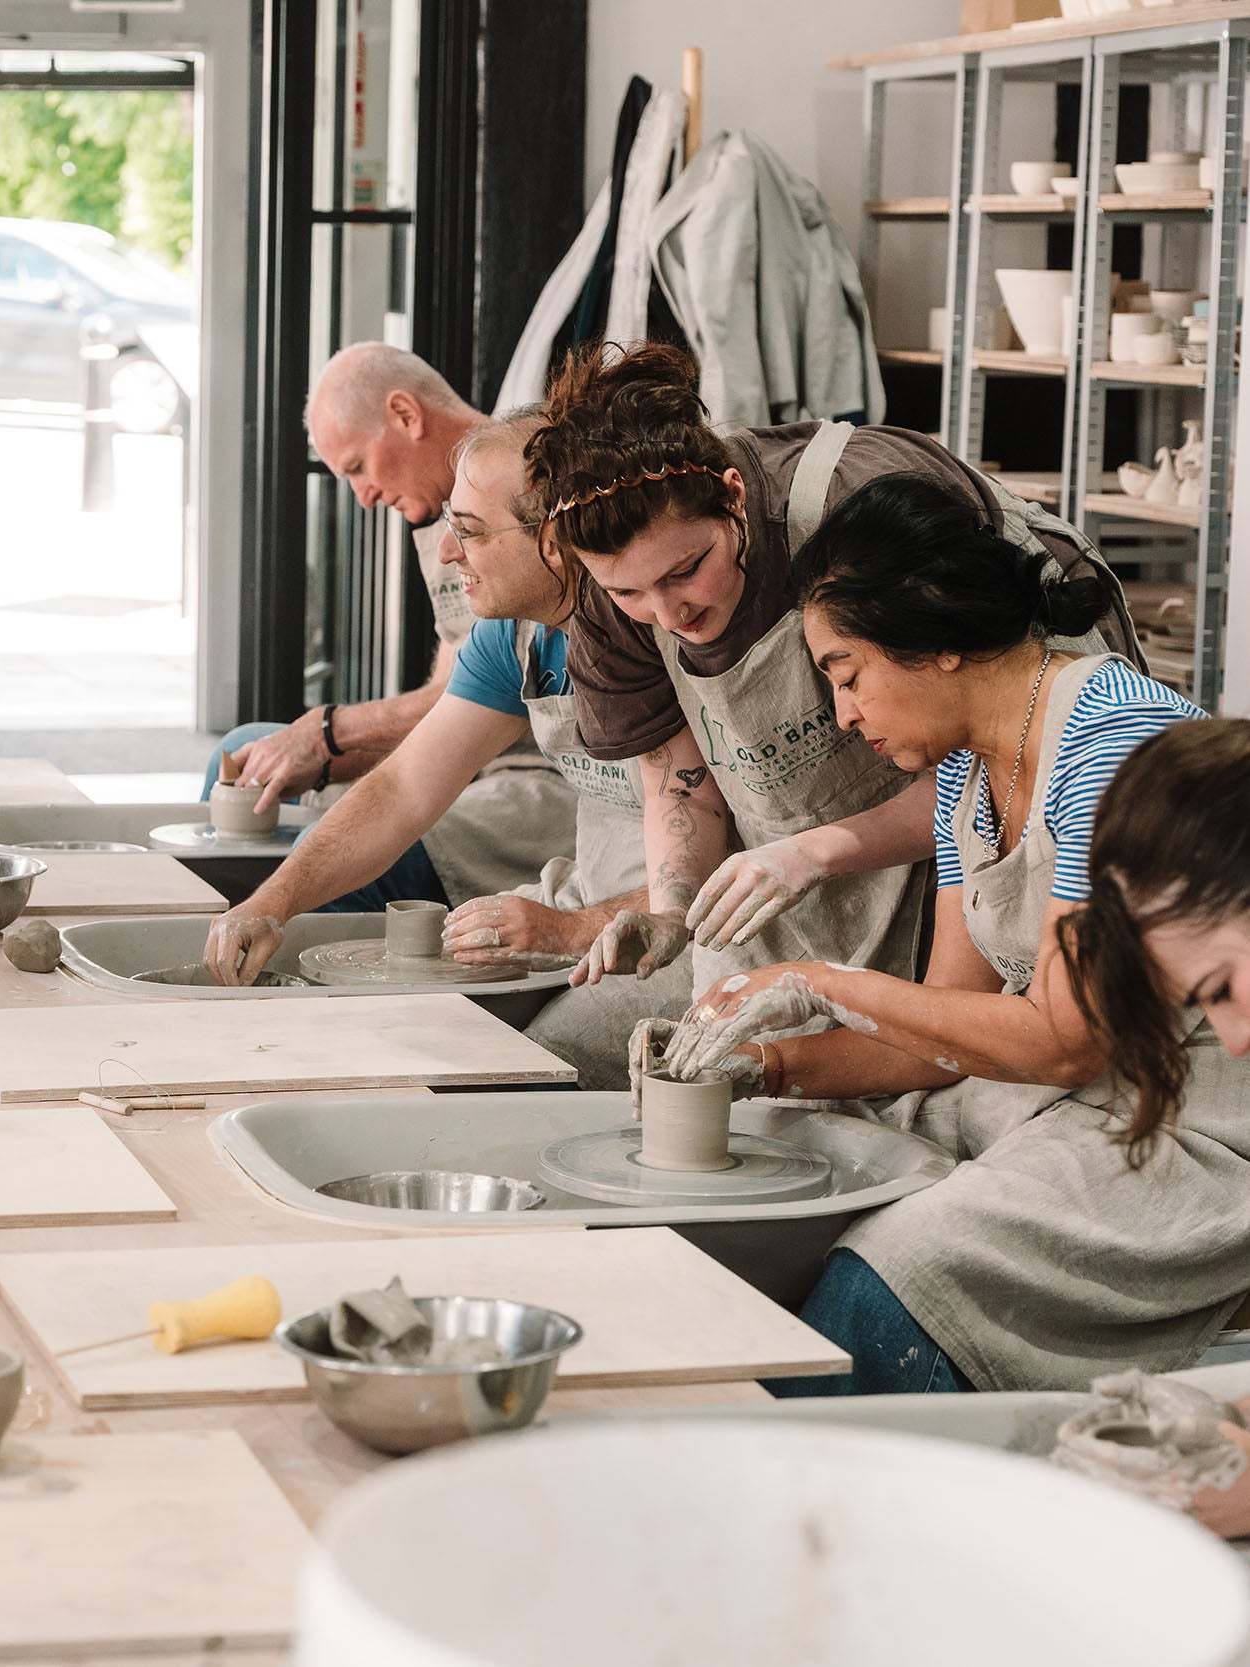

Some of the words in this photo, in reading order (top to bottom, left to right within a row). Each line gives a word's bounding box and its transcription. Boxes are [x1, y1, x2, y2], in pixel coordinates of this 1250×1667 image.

[772, 720, 791, 734] THE
[804, 725, 836, 746] STUD
[736, 744, 777, 763] OLD
[562, 755, 590, 771] OLD
[594, 762, 628, 781] BANK
[997, 955, 1027, 975] OLD
